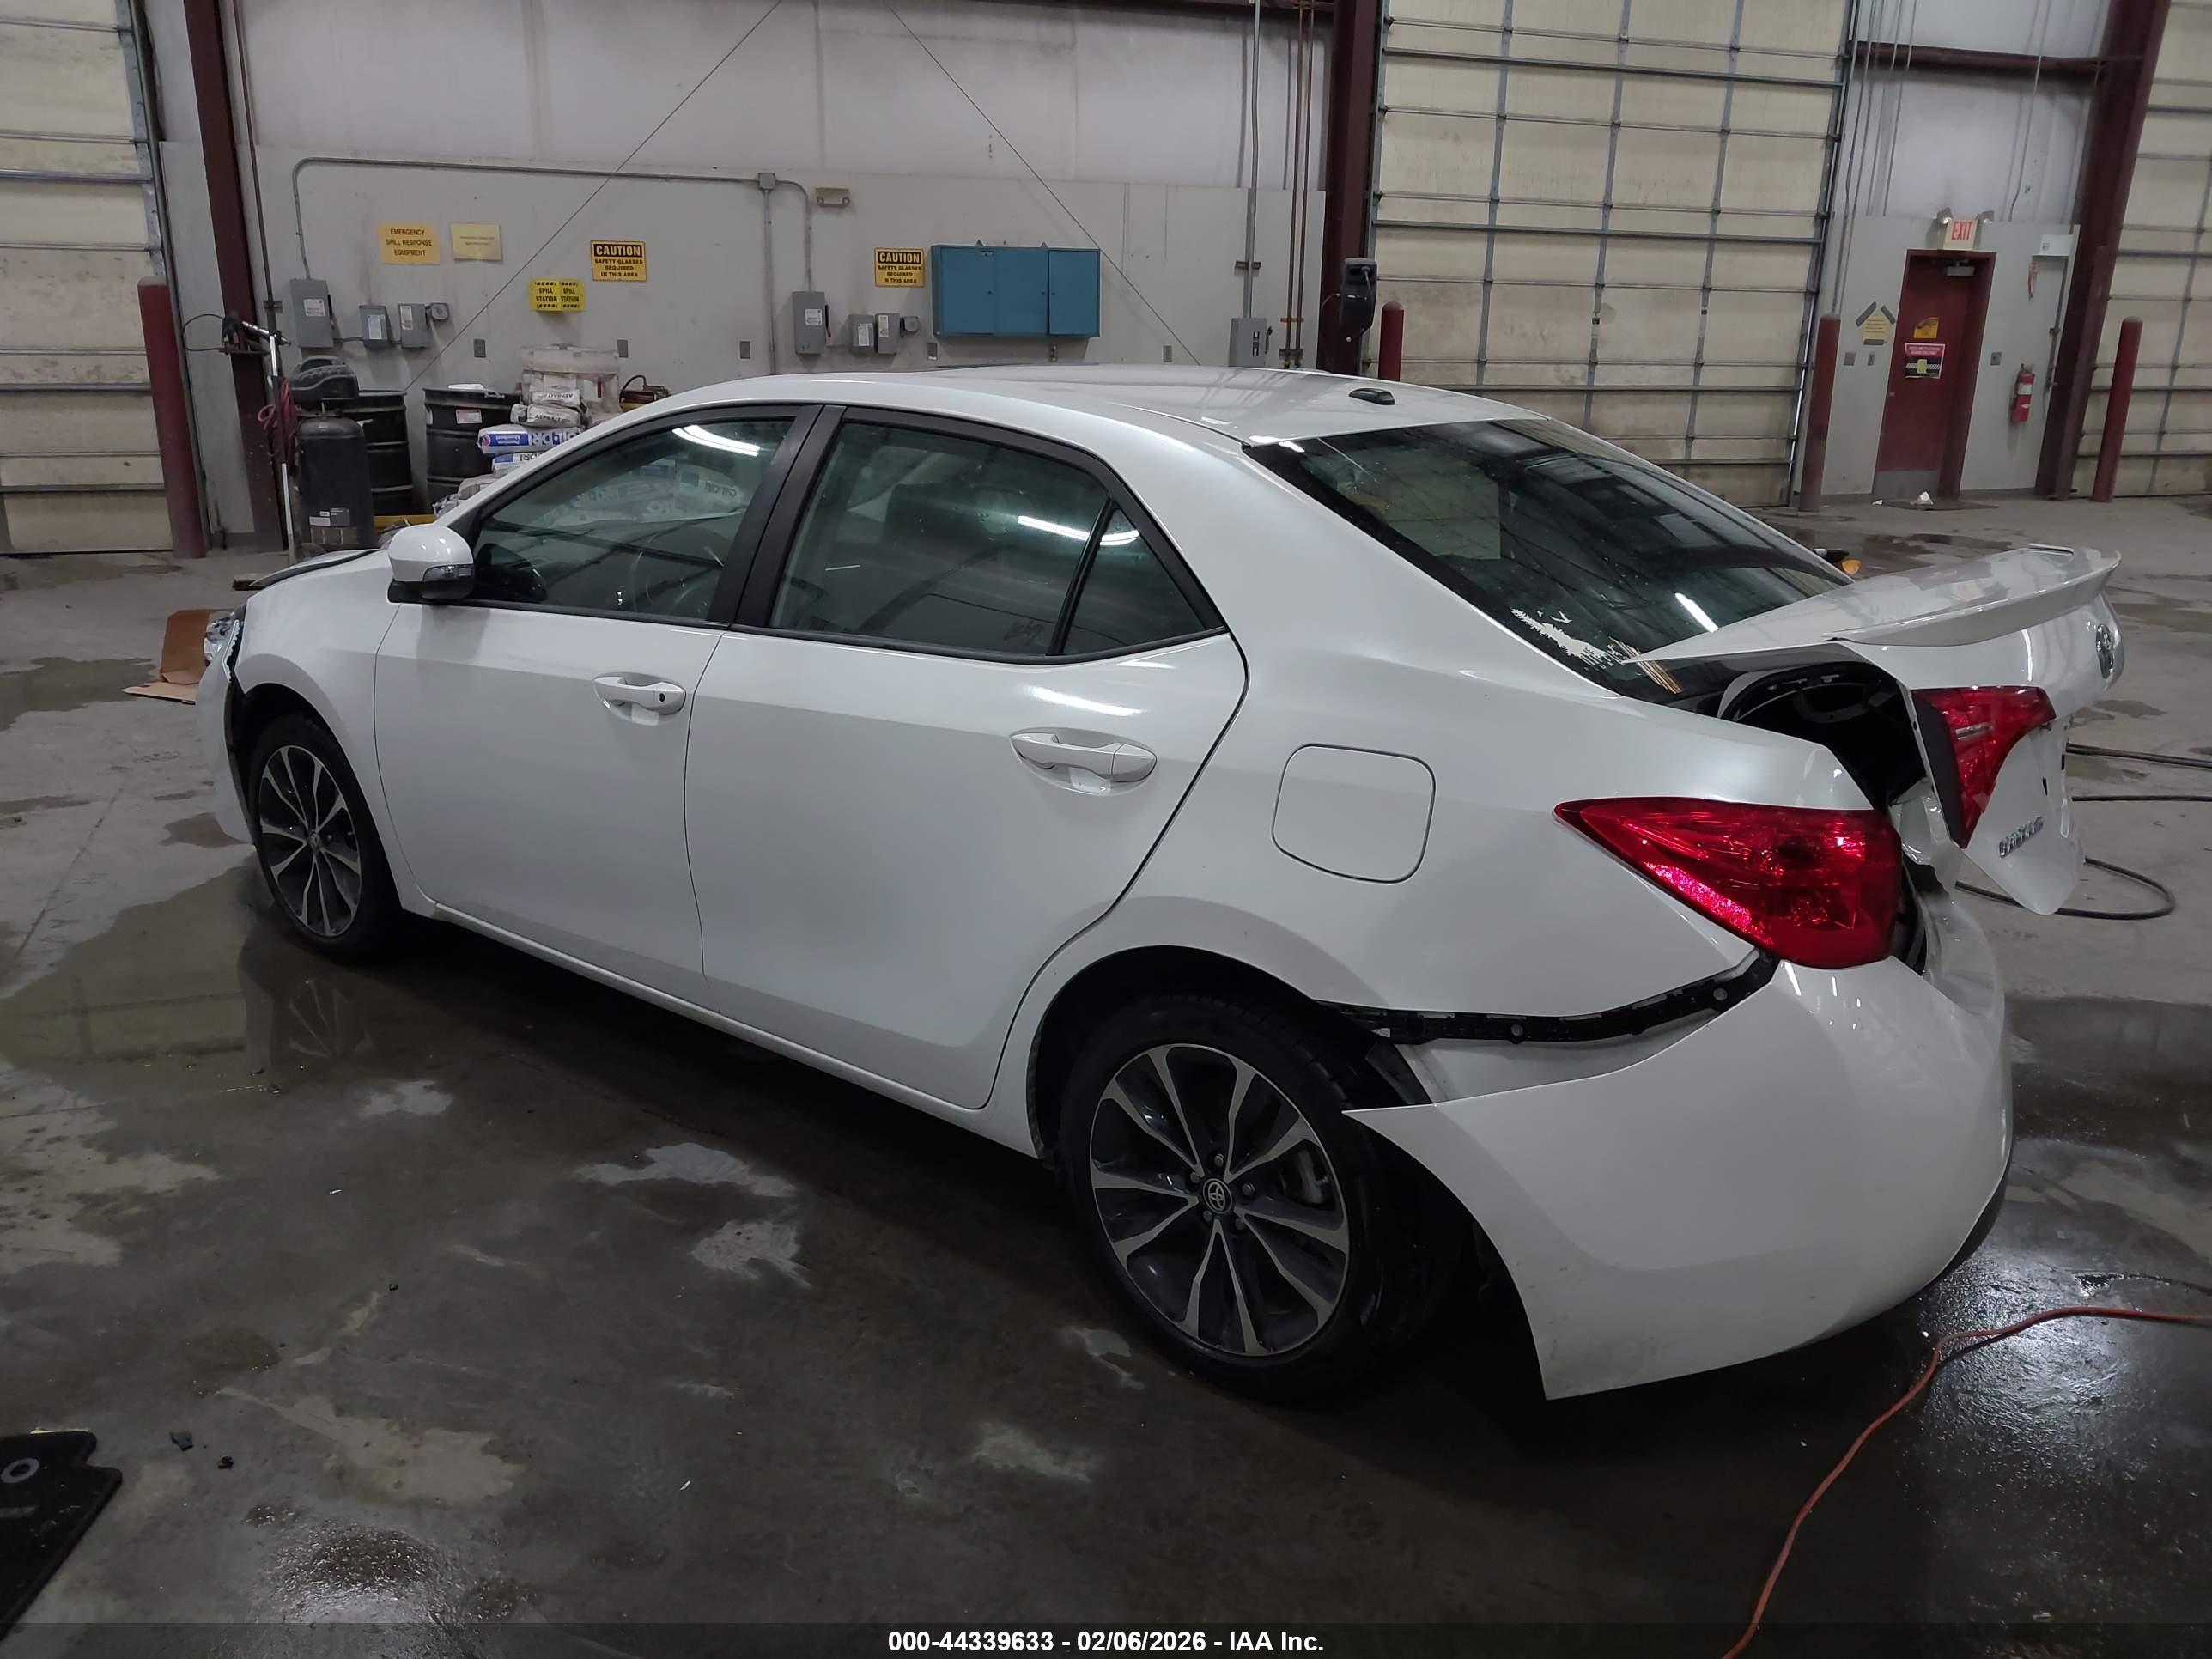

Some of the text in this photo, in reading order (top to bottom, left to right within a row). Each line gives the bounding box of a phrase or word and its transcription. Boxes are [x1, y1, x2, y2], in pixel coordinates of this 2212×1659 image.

[1951, 220, 1973, 240] EXIT
[596, 245, 641, 256] CAUTION
[879, 252, 920, 263] CAUTION
